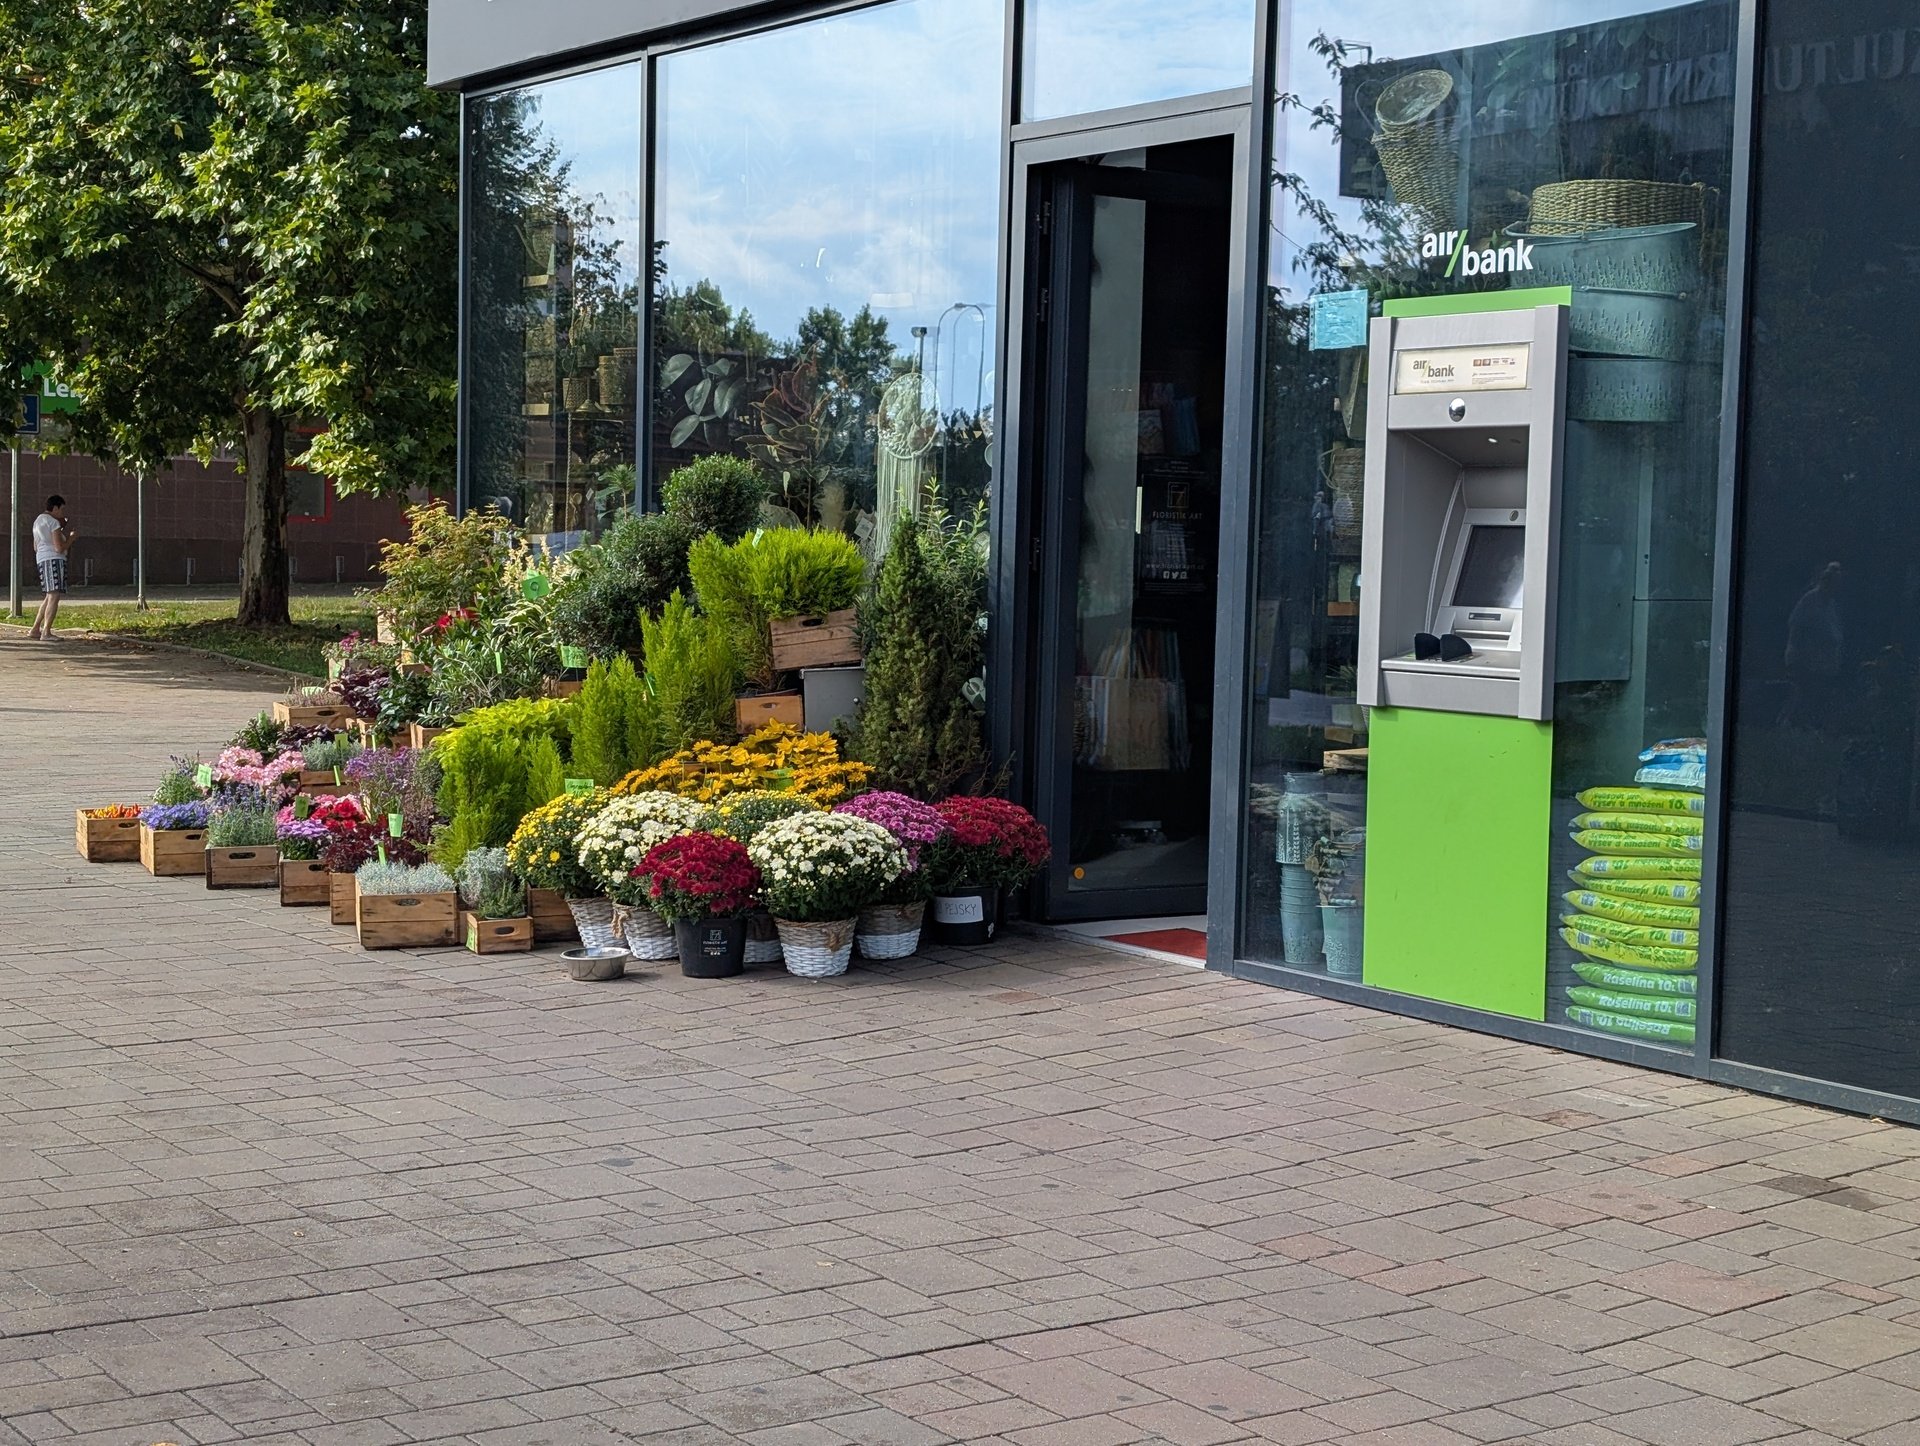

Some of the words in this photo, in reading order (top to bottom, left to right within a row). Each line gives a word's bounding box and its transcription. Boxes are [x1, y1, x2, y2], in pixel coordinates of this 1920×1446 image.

[1421, 230, 1458, 258] air
[1462, 239, 1534, 277] bank
[1428, 364, 1455, 377] bank
